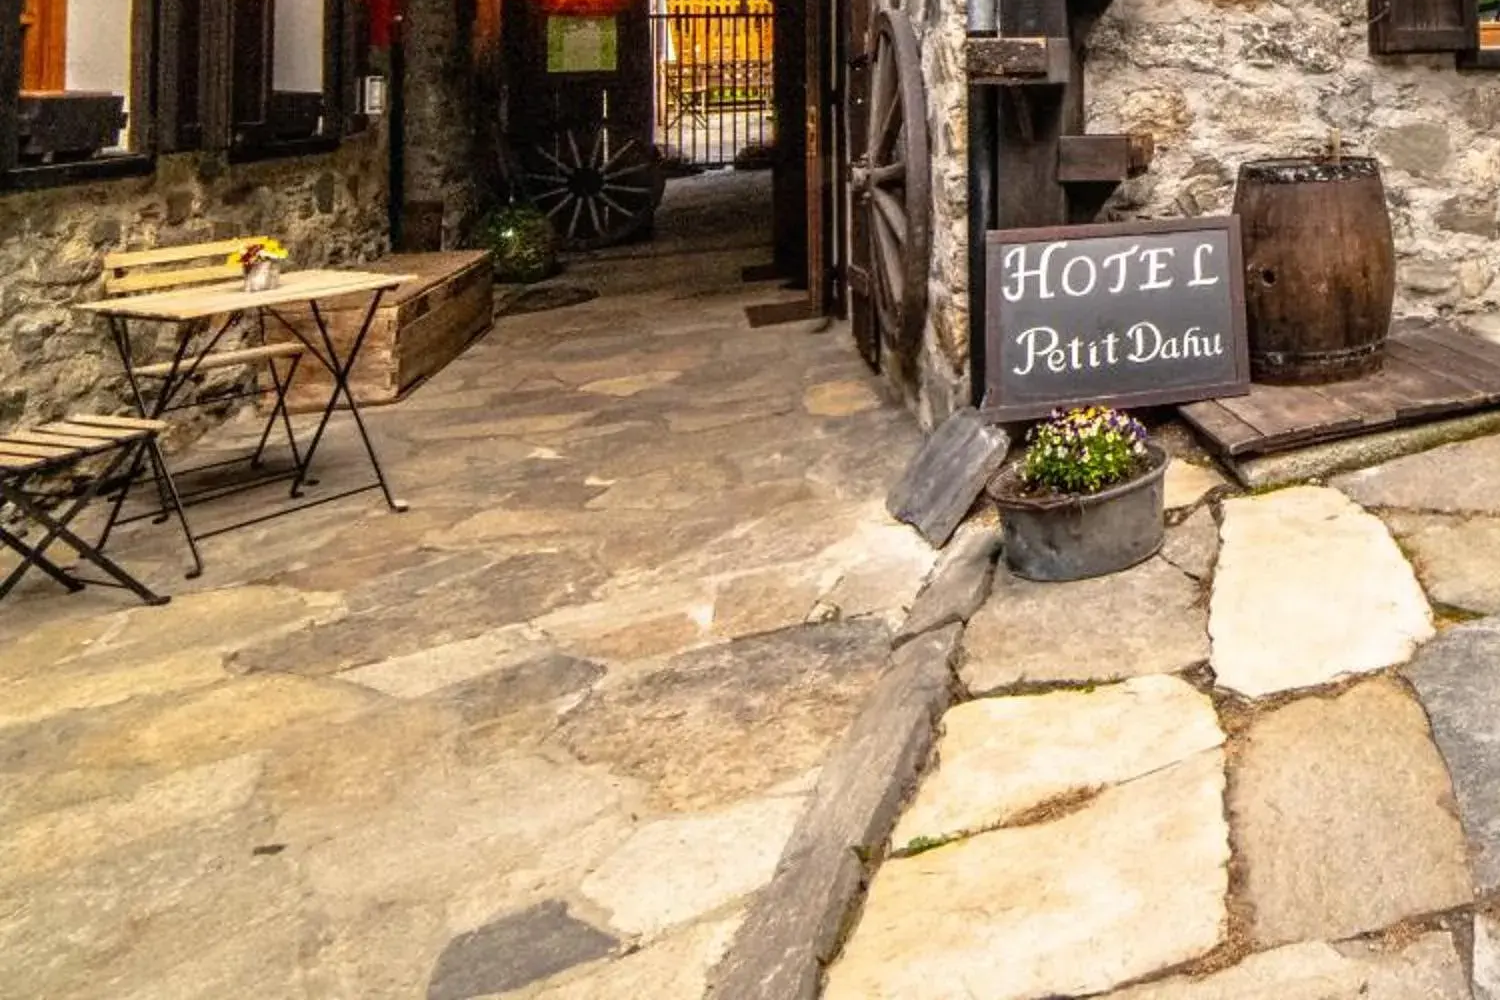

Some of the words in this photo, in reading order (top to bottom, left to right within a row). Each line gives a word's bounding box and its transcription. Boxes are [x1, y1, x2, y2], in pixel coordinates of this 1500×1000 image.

[1002, 241, 1219, 302] HOTEL
[1013, 327, 1118, 375] Petit
[1126, 321, 1223, 363] Dahu
